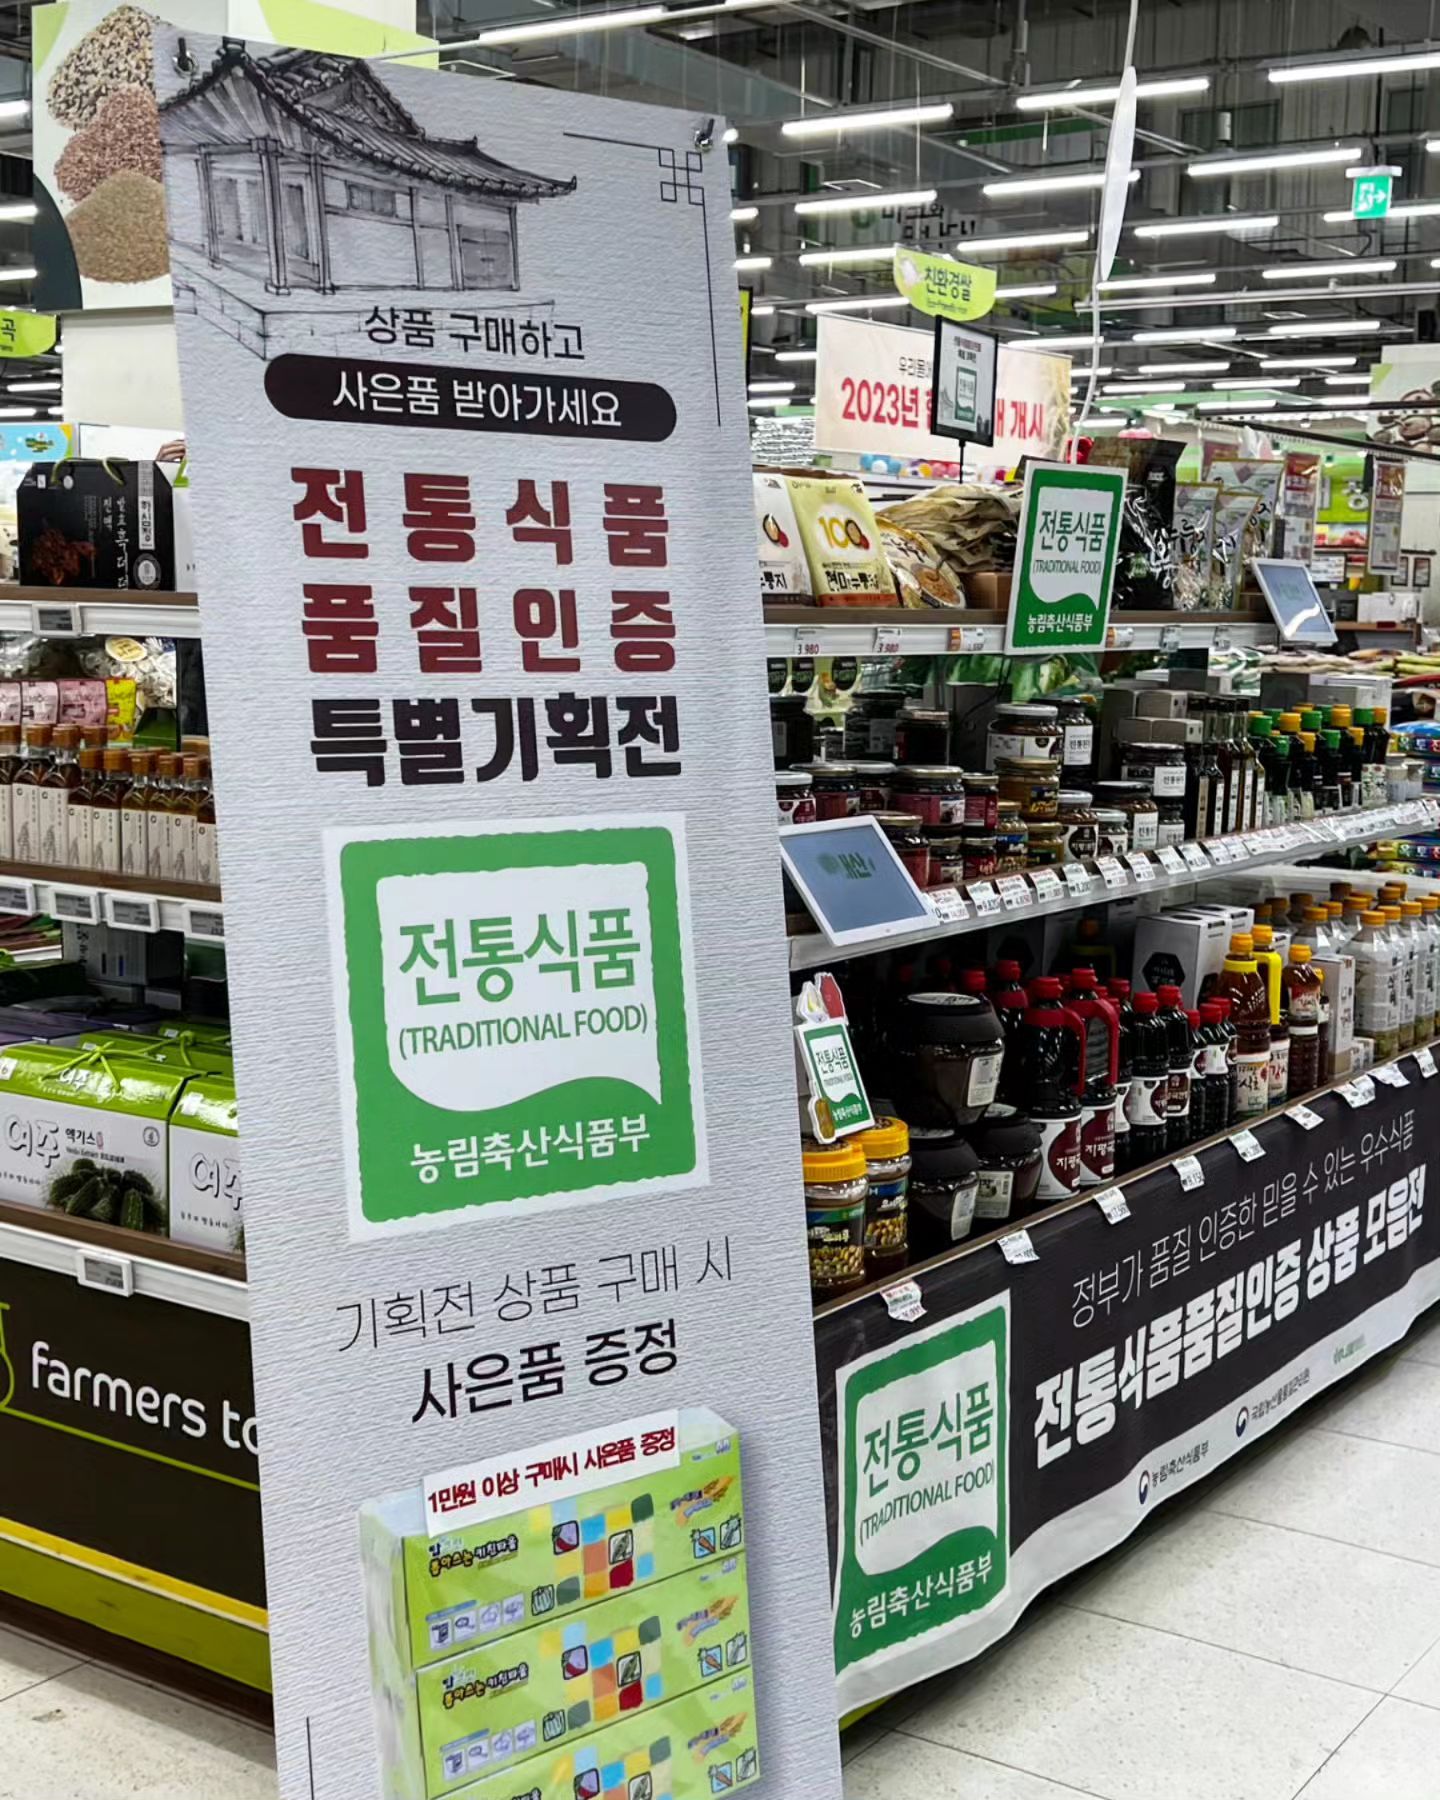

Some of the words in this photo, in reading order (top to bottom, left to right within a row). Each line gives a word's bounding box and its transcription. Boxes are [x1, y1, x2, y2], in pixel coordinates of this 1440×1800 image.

[924, 266, 972, 302] 친환경쌀
[364, 305, 435, 348] 상품
[449, 313, 585, 360] 구매하고
[333, 371, 440, 416] 사은품
[452, 380, 622, 427] 받아가세요
[841, 377, 919, 428] 2023년
[1010, 400, 1043, 440] 개시
[290, 466, 669, 567] 전통식품
[1039, 508, 1106, 553] 전통식품
[1032, 559, 1079, 575] (TRADITIONAL
[1080, 559, 1102, 574] FOOD)
[301, 583, 677, 673] 품질인증
[1027, 612, 1093, 634] 농림축산식품부
[310, 691, 682, 787] 특별기획전
[399, 907, 641, 1006] 전통식품
[399, 1012, 570, 1060] (TRADITIONAL
[575, 1003, 648, 1037] FOOD)
[815, 1046, 849, 1075] 전통식품
[5, 1115, 60, 1169] 여주
[410, 1114, 650, 1184] 농림축산식품부
[1072, 1249, 1142, 1328] 정부가
[1149, 1223, 1192, 1290] 품질
[1198, 1191, 1257, 1262] 인증한
[1262, 1171, 1297, 1228] 믿을
[1301, 1161, 1322, 1203] 수
[1323, 1146, 1356, 1195] 있는
[1360, 1108, 1415, 1174] 우수식품
[336, 1280, 475, 1352] 기획전
[493, 1263, 580, 1322] 상품
[598, 1244, 679, 1303] 구매
[696, 1235, 732, 1284] 시
[1033, 1238, 1302, 1470] 전통식품품질인증
[1305, 1204, 1361, 1300] 상품
[1362, 1162, 1427, 1265] 모음전
[32, 1340, 207, 1438] farmers
[411, 1341, 566, 1423] 사은품
[584, 1318, 678, 1387] 증정
[427, 1480, 477, 1514] 1만원
[481, 1468, 520, 1498] 이상
[524, 1452, 579, 1487] 구매시
[583, 1436, 636, 1470] 사은품
[640, 1426, 676, 1457] 증정
[863, 1381, 994, 1499] 전통식품
[1151, 1439, 1209, 1489] 농림축산식품부
[859, 1480, 952, 1547] (TRADITIONAL
[955, 1459, 995, 1498] FOOD)
[849, 1550, 993, 1639] 농림축산식품부
